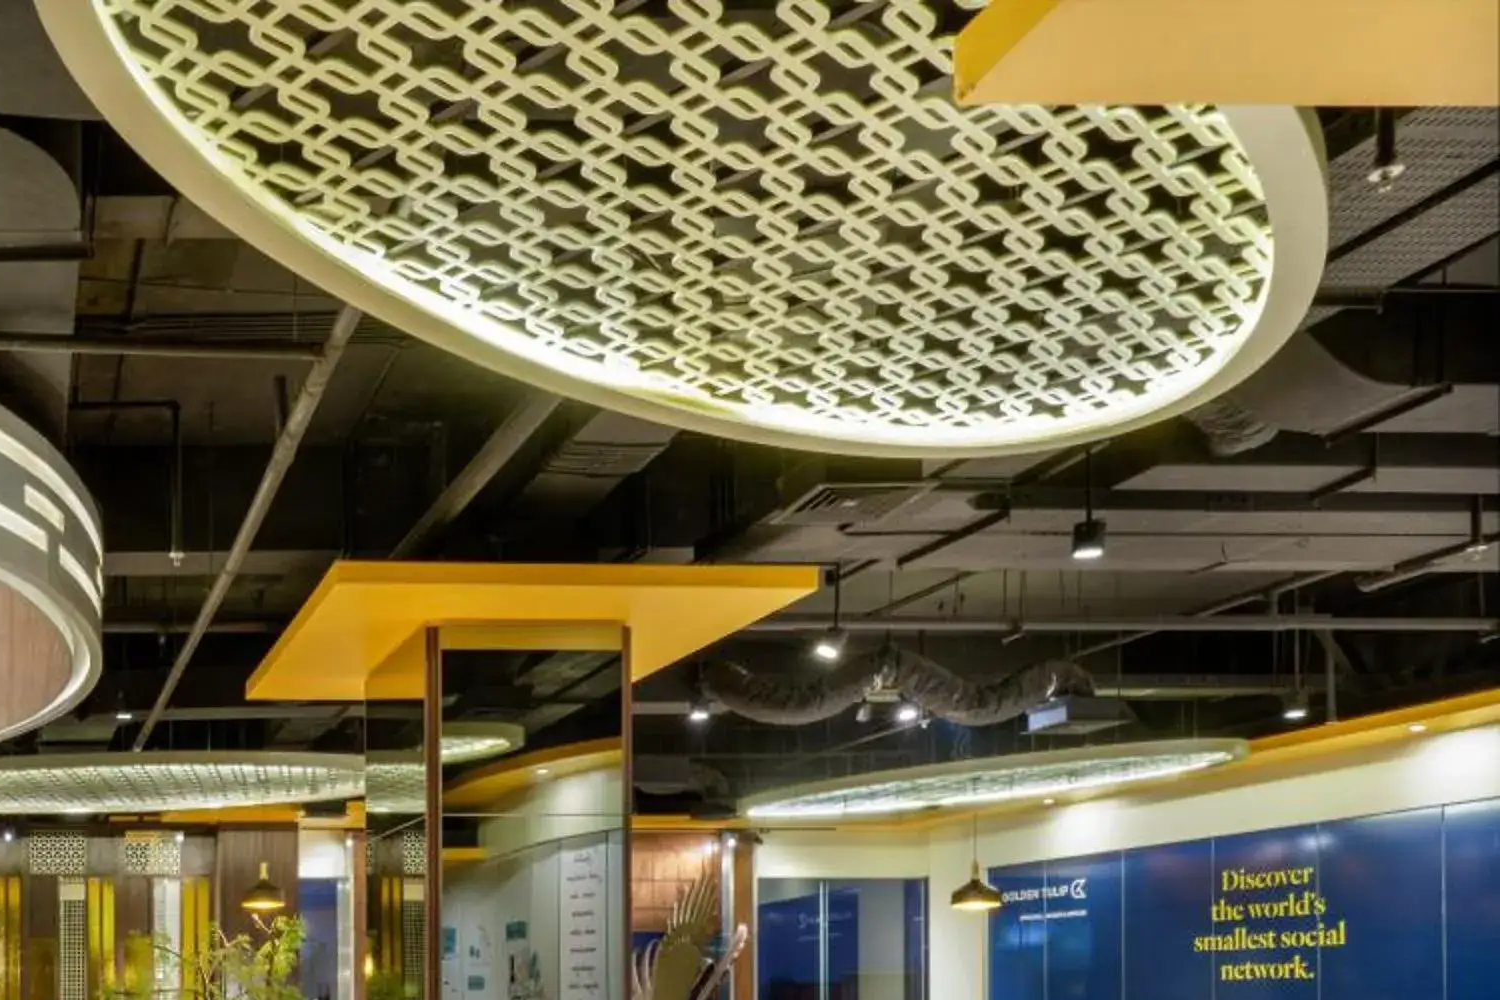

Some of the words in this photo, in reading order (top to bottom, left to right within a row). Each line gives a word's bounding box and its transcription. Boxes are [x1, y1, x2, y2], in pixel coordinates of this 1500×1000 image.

[1221, 866, 1315, 892] Discover
[1211, 897, 1245, 921] the
[1193, 926, 1277, 952] smallest
[1279, 920, 1347, 949] social
[1220, 954, 1316, 981] network.
